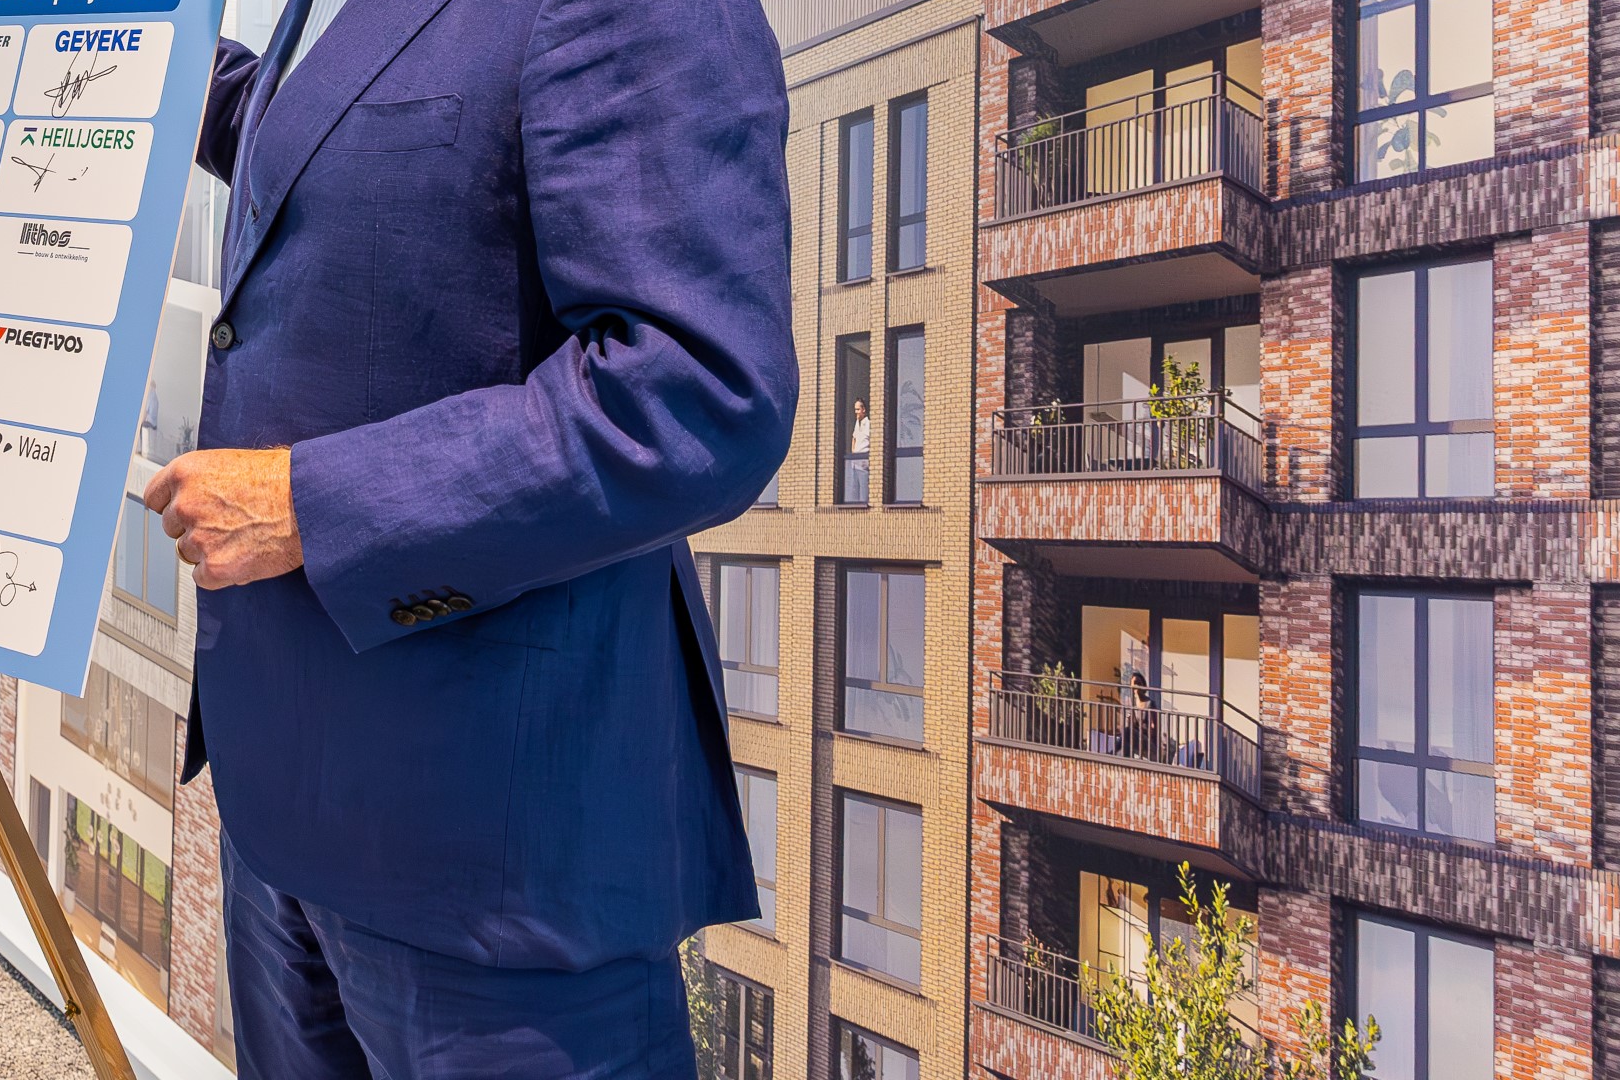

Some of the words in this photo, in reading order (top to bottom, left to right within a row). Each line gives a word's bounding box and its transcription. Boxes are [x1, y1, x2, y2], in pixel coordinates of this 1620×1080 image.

[55, 28, 142, 52] GEVEKE
[41, 127, 136, 150] HEILIJGERS
[20, 222, 71, 247] lithos
[5, 328, 83, 353] PLEGT-VOS
[18, 435, 57, 463] Waal
